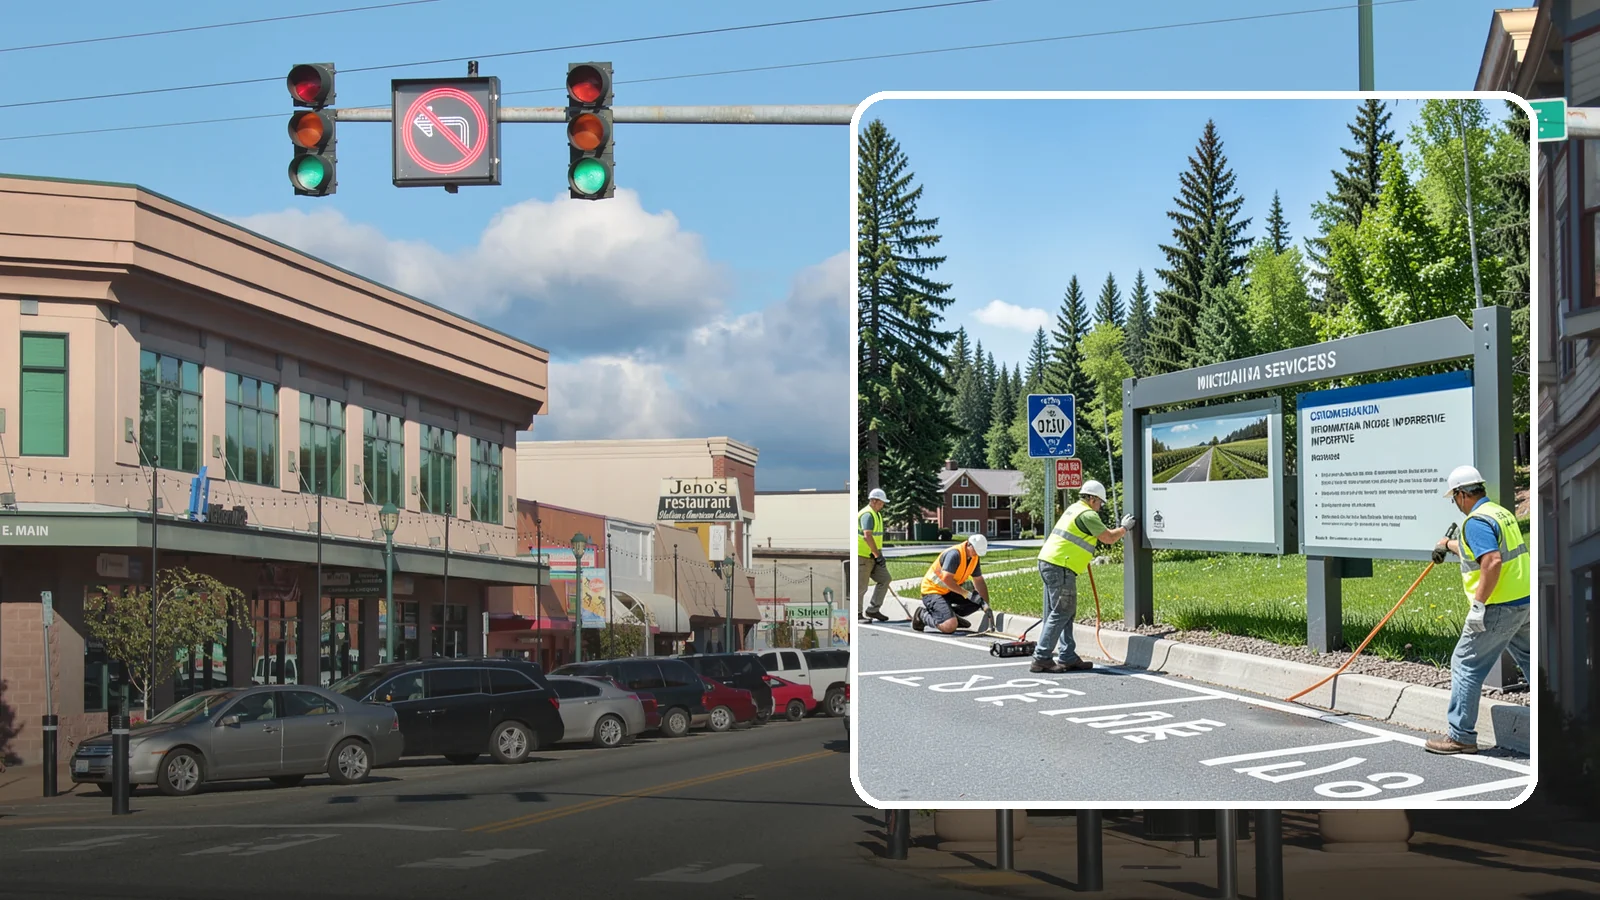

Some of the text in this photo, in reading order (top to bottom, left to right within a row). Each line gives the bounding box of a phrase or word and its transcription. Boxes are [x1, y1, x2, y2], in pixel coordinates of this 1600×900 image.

[669, 480, 728, 494] Jeno's
[665, 496, 731, 509] restaurant
[686, 509, 715, 519] American
[715, 509, 738, 519] Cuisine
[2, 525, 49, 536] E. MAIN
[797, 607, 828, 617] Street
